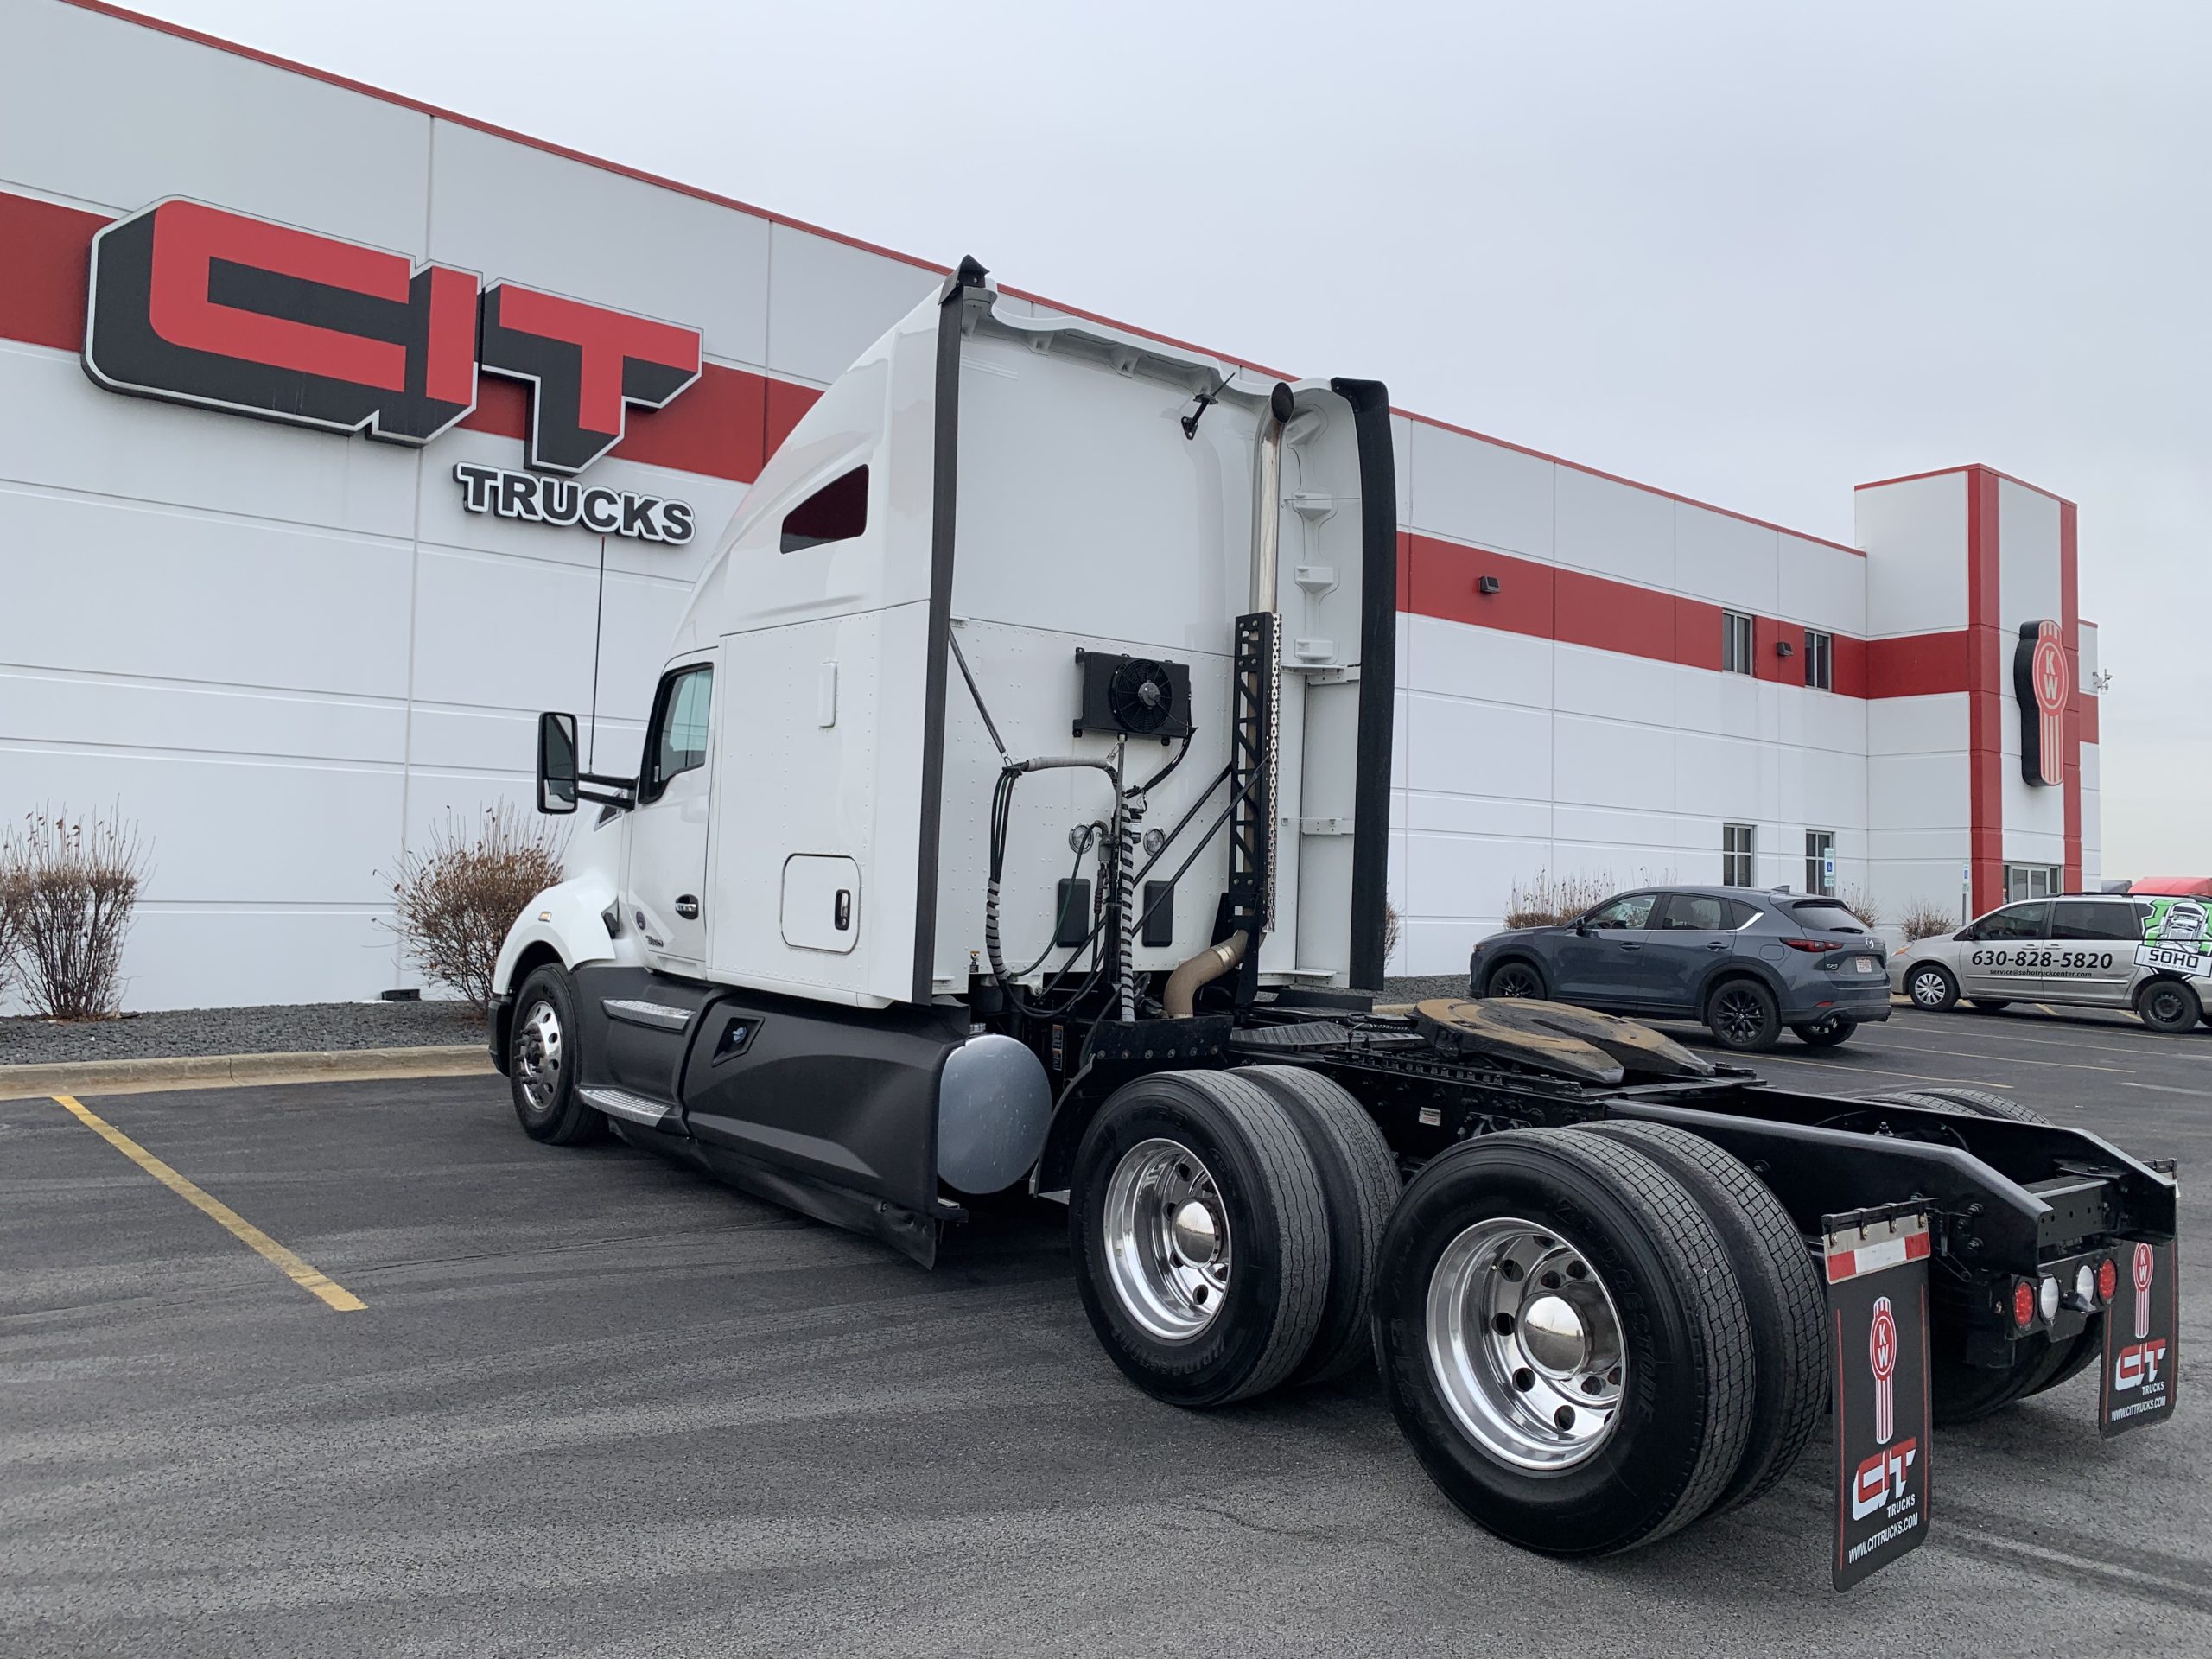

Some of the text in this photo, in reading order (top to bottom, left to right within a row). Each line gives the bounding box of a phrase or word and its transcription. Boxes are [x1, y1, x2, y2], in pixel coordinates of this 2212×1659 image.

[85, 195, 703, 474] CIT
[453, 461, 696, 546] TRUCKS
[1972, 950, 2113, 969] 630-828-5820
[2149, 950, 2199, 968] SOHO
[1989, 969, 2092, 977] service@sohotruckcenter.com
[2115, 1338, 2166, 1391] CIT
[2141, 1381, 2164, 1395] TRUCKS
[2111, 1396, 2166, 1422] WWW.CITTRUCKS.COM
[1853, 1437, 1916, 1521] CIT
[1886, 1493, 1916, 1519] TRUCKS
[1848, 1513, 1918, 1564] WWW.CITTRUCKS.COM
